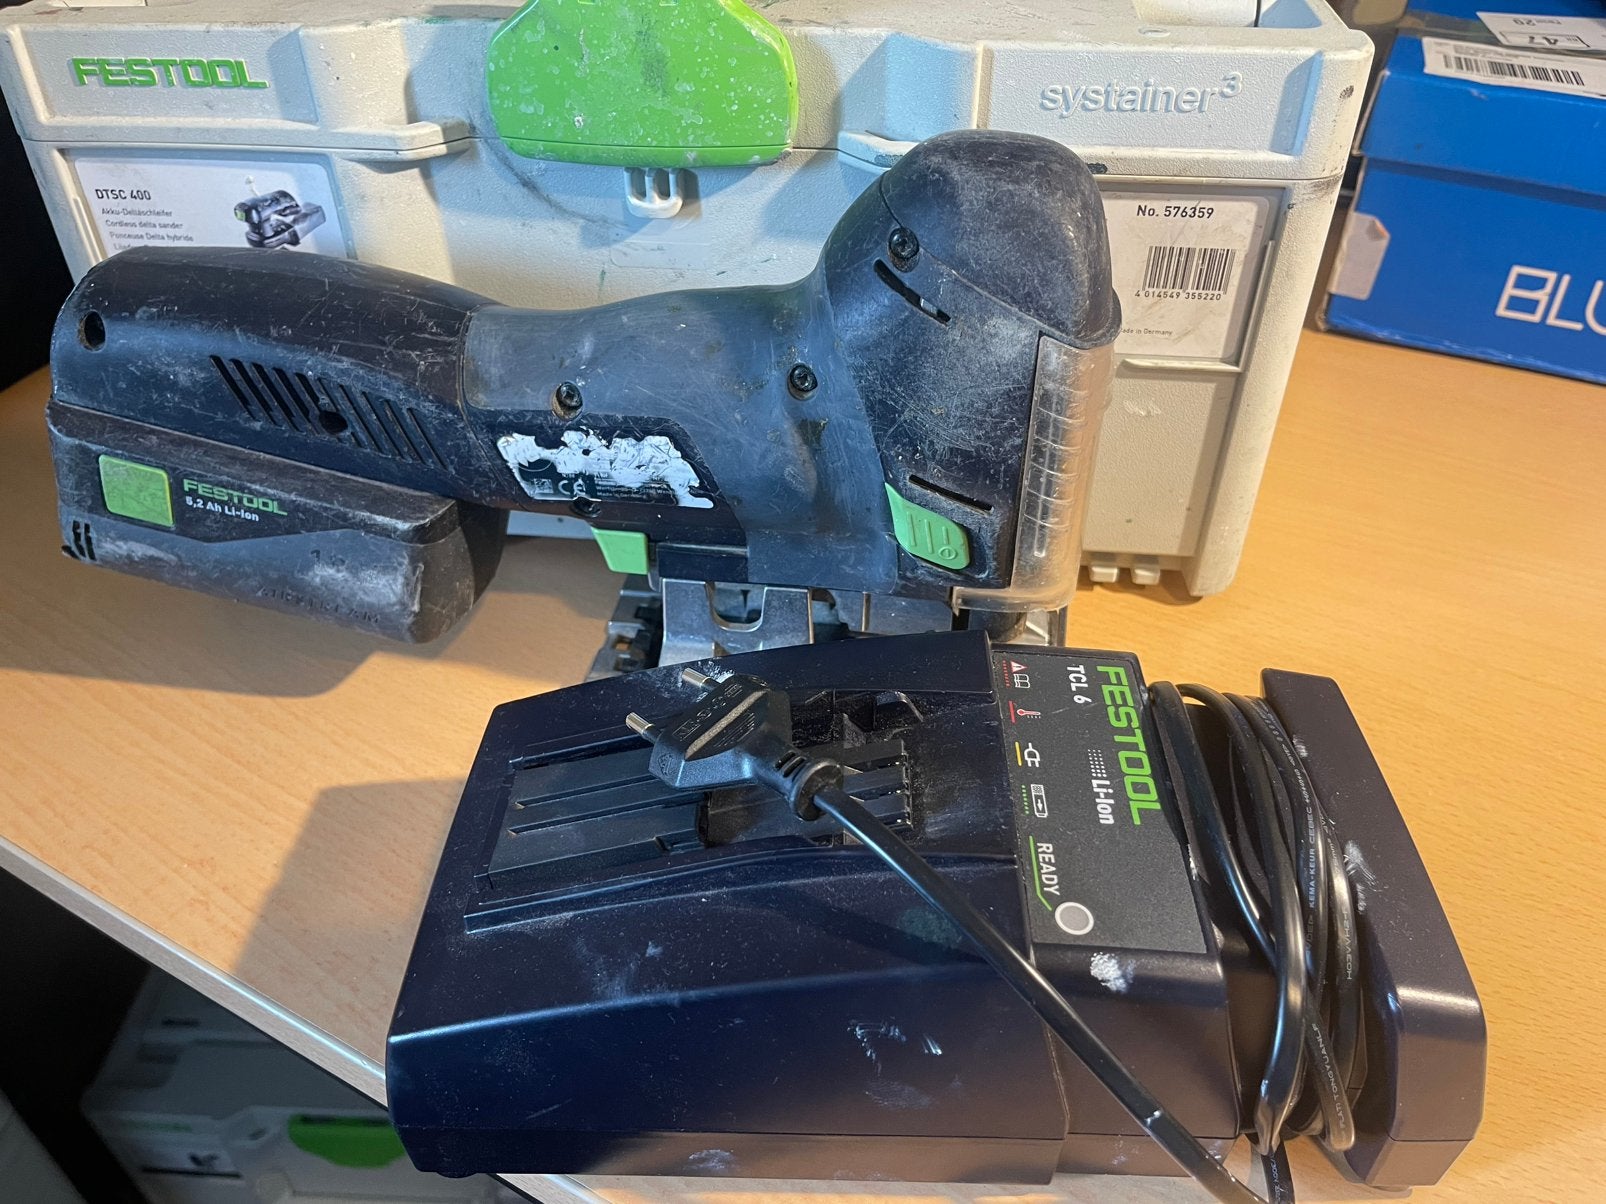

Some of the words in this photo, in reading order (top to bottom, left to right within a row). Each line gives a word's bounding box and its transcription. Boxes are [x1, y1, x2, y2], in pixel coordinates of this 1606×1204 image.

[71, 57, 270, 89] FESTOOL
[94, 188, 128, 200] DTSC
[130, 189, 152, 201] 400
[1136, 204, 1160, 217] No.
[1163, 205, 1215, 219] 576359
[1144, 290, 1181, 299] 014549
[1184, 292, 1222, 301] 355220
[1143, 328, 1173, 336] Germany
[182, 478, 288, 517] FESTOOL
[185, 496, 205, 509] 5,2
[205, 498, 222, 513] Ah
[224, 502, 260, 522] Li-Ion
[1066, 664, 1088, 693] TCL
[1075, 694, 1092, 705] 6
[1096, 664, 1162, 826] FESTOOL
[1091, 778, 1114, 825] Li-Ion
[1036, 842, 1060, 897] READY
